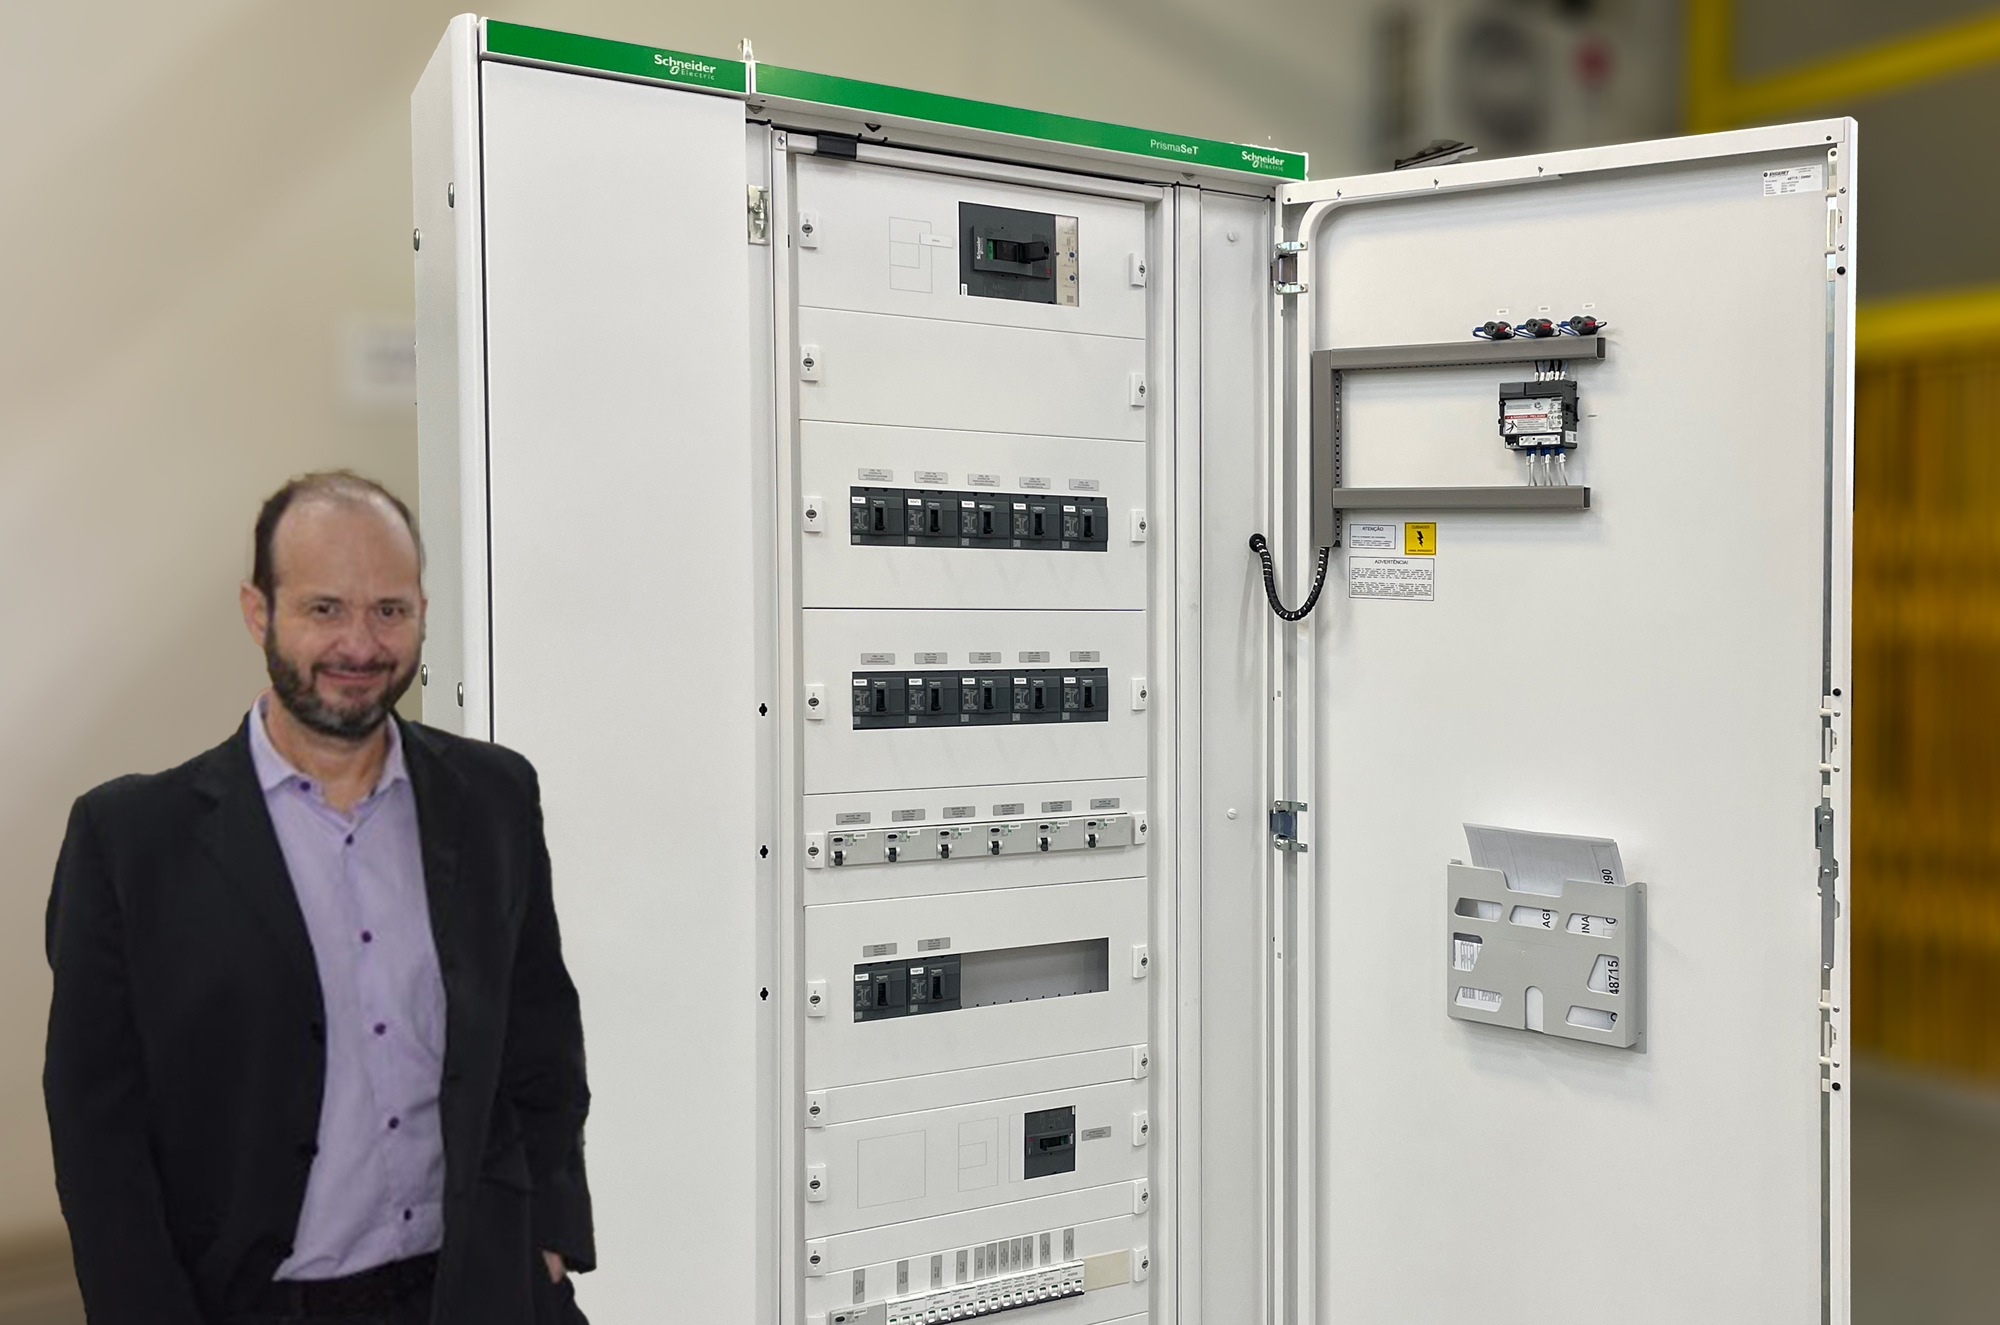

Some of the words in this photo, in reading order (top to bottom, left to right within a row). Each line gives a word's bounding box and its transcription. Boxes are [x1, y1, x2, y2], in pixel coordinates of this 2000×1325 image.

[654, 54, 716, 73] Schneider
[681, 68, 715, 80] Electric
[1150, 139, 1199, 155] PrismaSeT
[1241, 151, 1285, 166] Schneider
[1608, 960, 1619, 994] 48715
